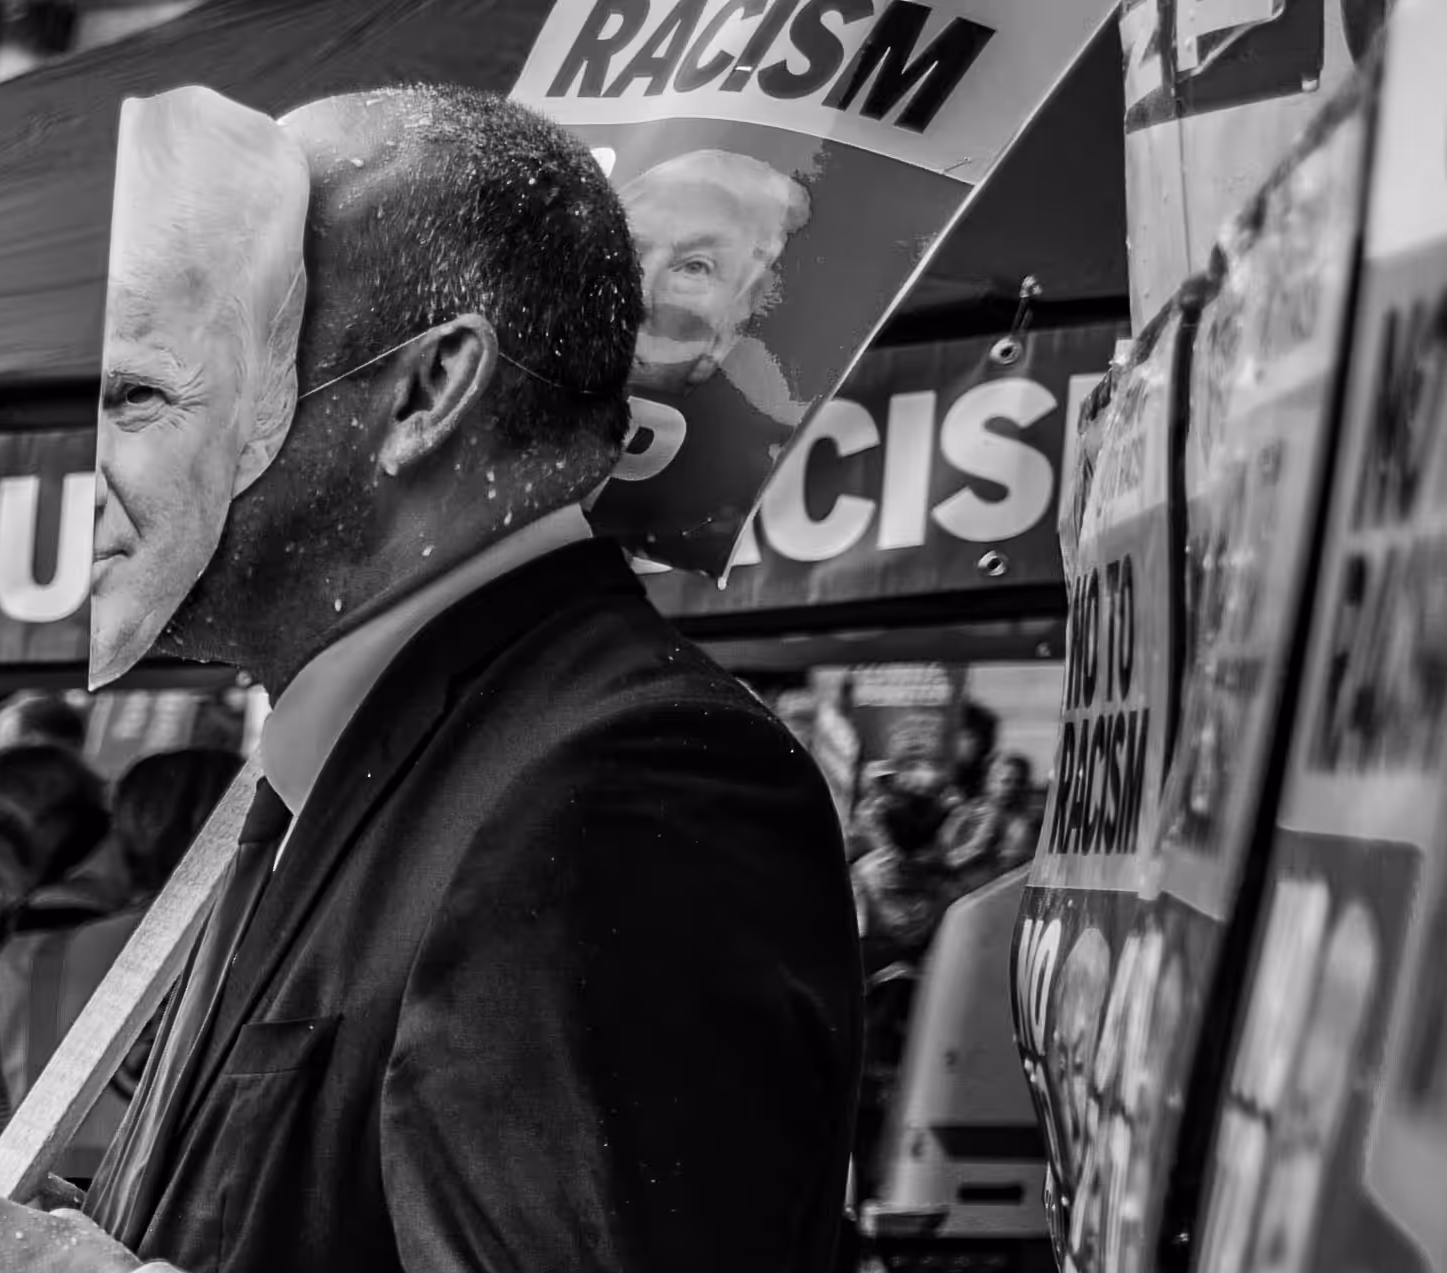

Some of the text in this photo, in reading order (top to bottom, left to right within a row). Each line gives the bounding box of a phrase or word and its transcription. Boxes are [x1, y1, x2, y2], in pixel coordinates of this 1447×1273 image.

[546, 0, 996, 134] RACISM
[739, 373, 1106, 563] CIS
[1066, 566, 1099, 711] NO
[1106, 553, 1134, 702] TO
[1048, 708, 1151, 855] RACISM
